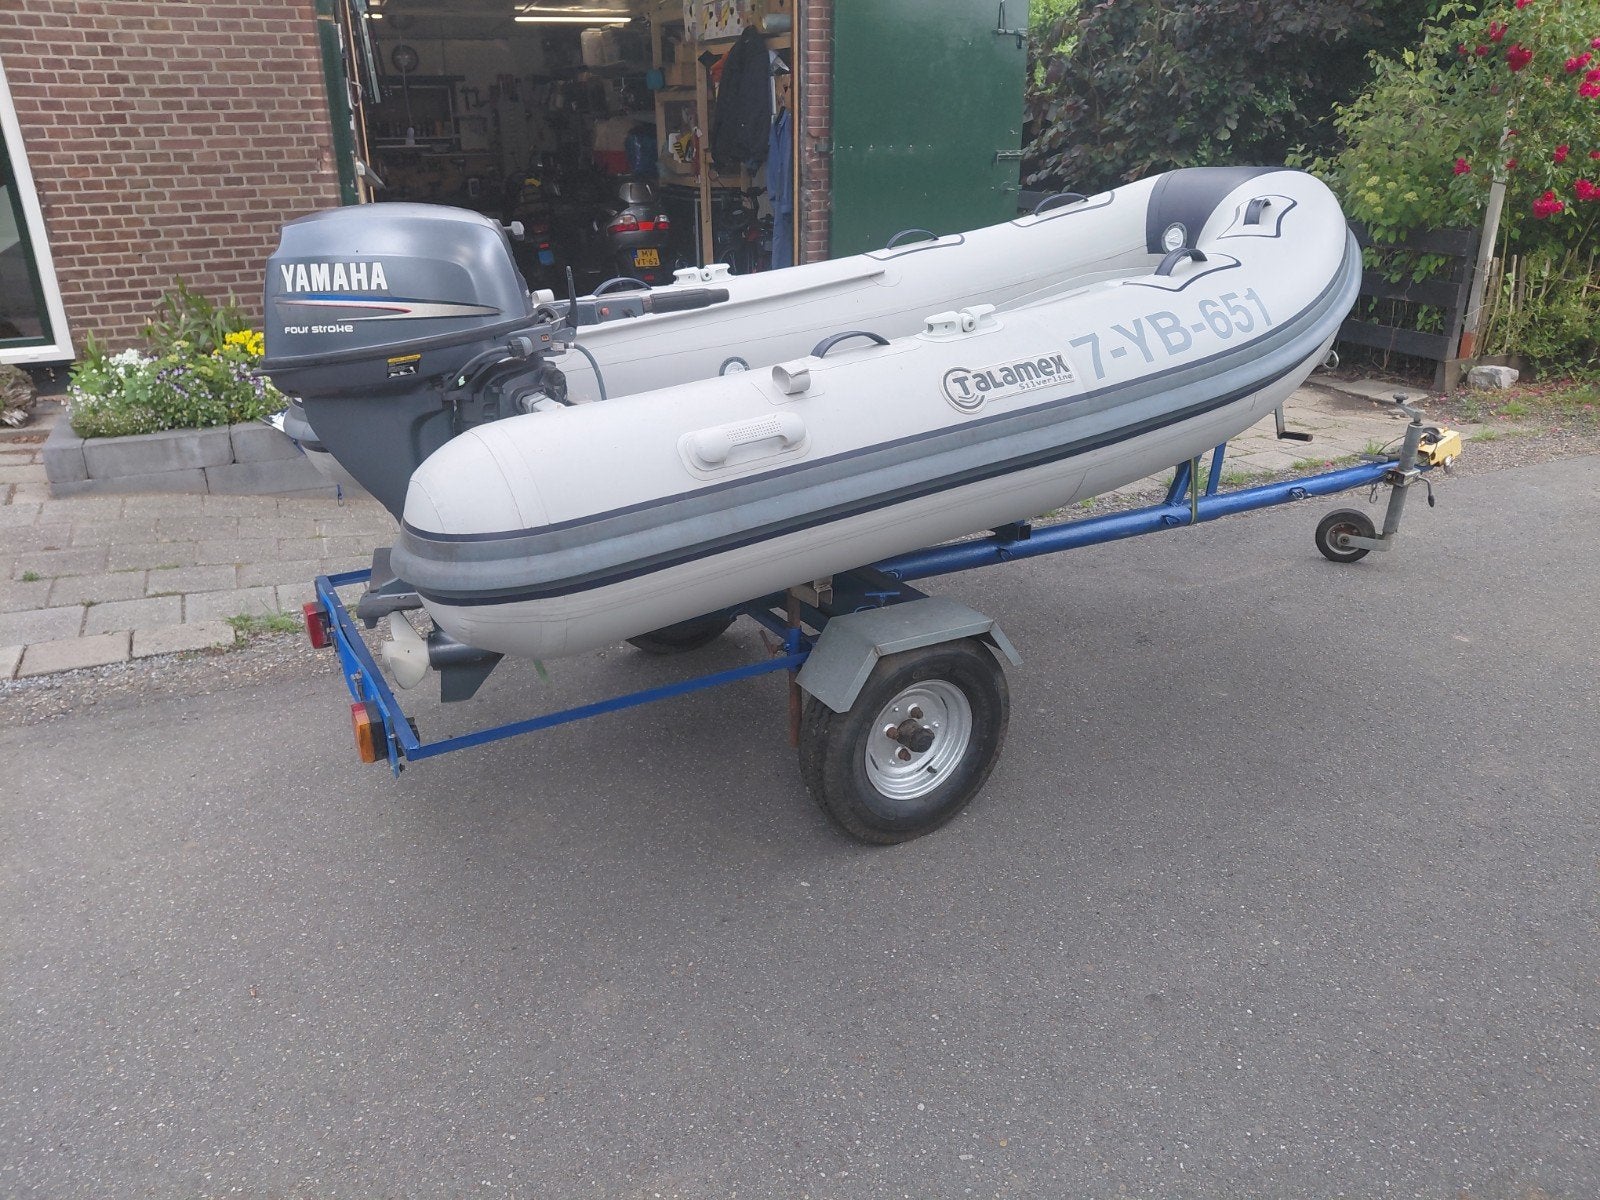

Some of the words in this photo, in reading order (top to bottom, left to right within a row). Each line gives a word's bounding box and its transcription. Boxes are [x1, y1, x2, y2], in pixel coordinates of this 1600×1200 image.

[280, 262, 388, 292] YAMAHA
[1068, 287, 1273, 380] 7-YB-651
[1018, 372, 1074, 391] Silverline
